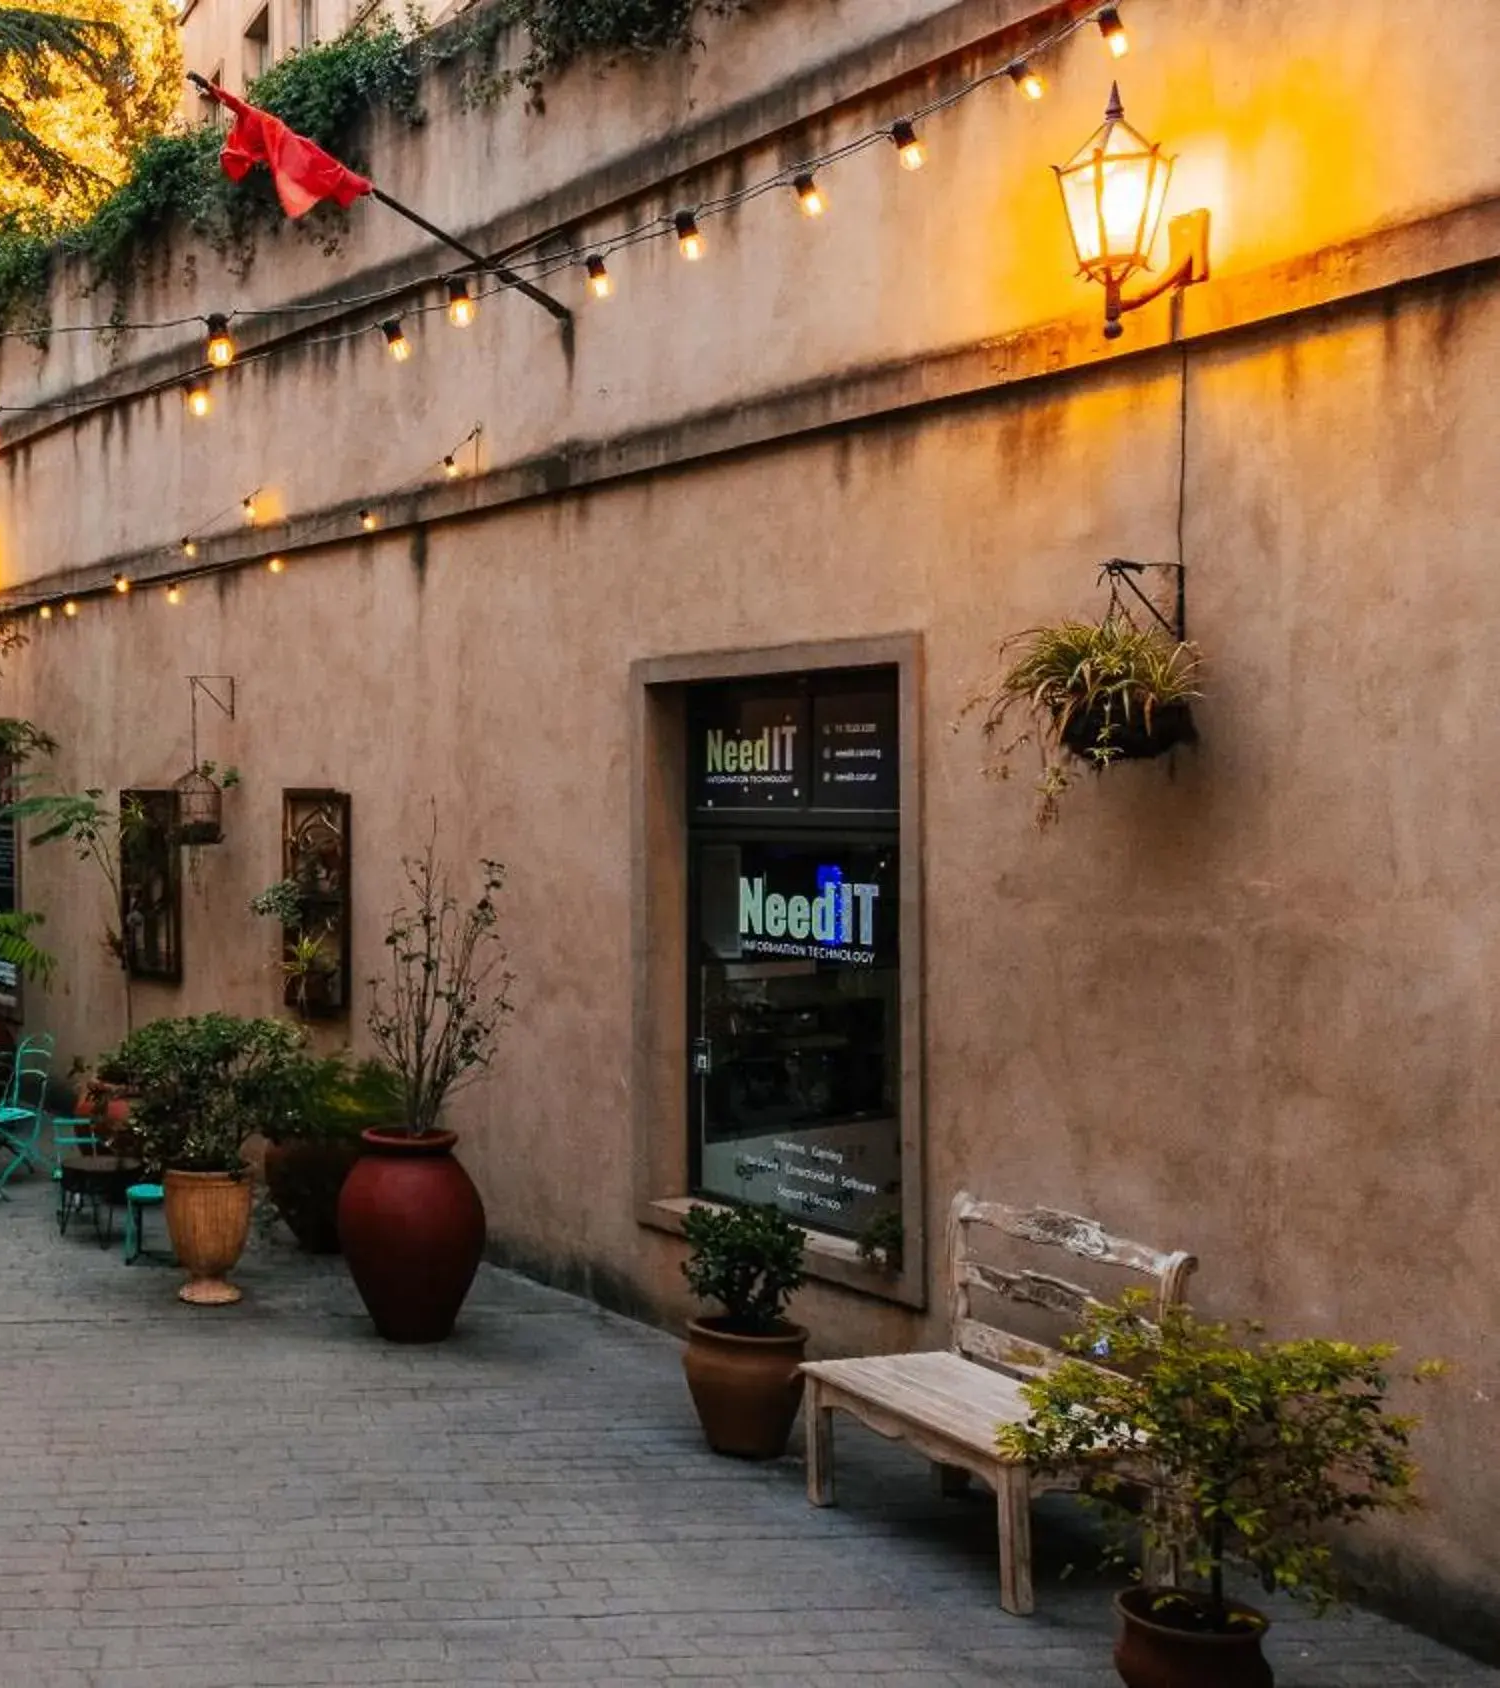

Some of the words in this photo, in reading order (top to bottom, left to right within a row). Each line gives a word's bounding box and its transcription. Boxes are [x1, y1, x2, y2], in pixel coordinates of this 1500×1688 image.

[706, 725, 797, 773] NeedIT
[739, 876, 880, 945] NeedIT
[740, 938, 807, 957] INFORMATION
[807, 944, 876, 964] TECHNOLOGY
